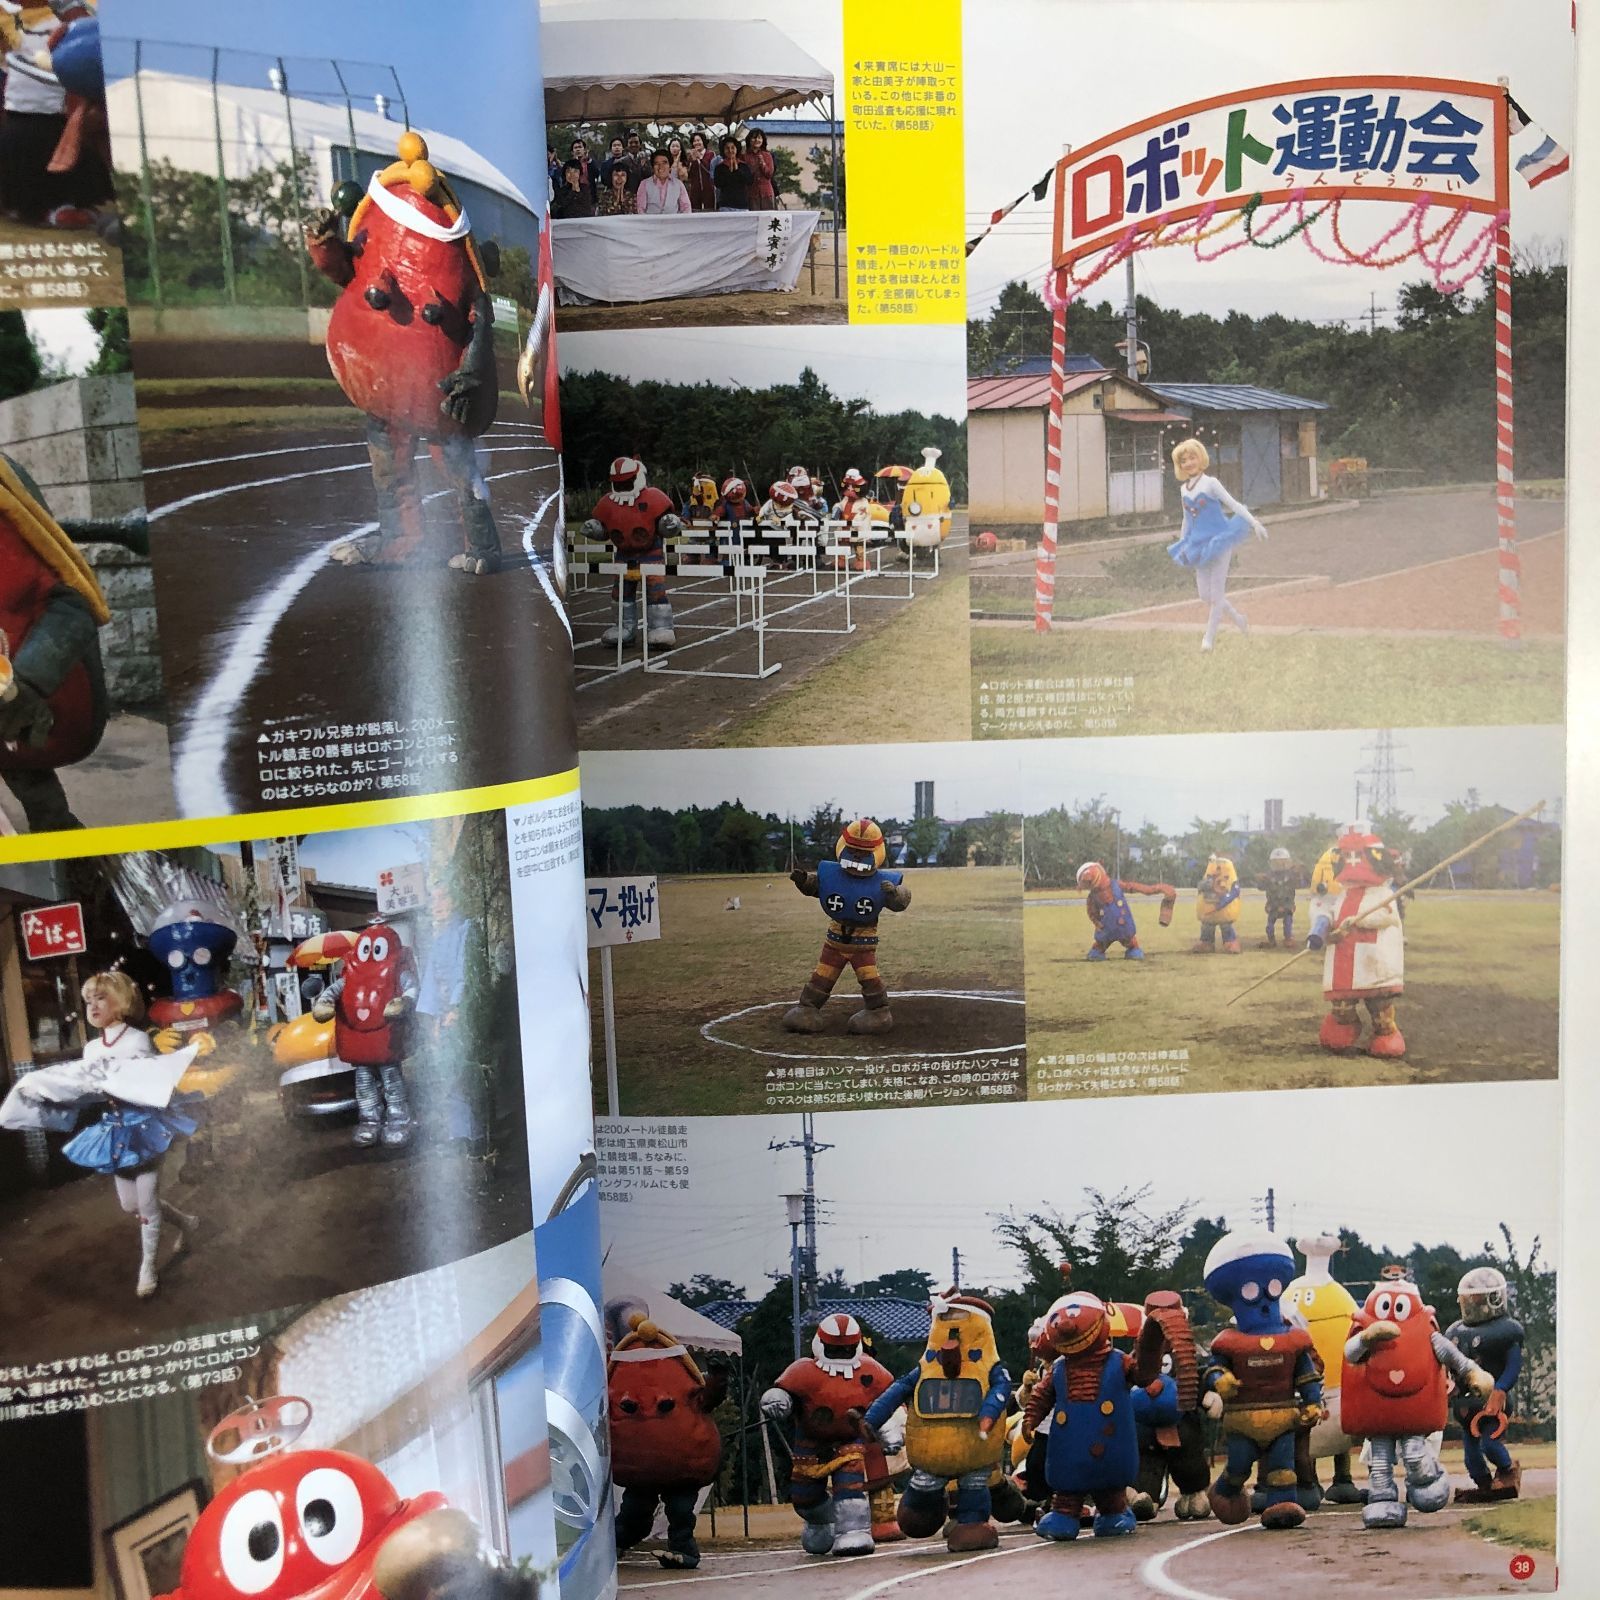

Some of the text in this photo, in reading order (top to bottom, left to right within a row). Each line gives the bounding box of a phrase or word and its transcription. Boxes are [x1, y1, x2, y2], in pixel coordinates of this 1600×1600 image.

[852, 76, 957, 87] 家と由美子が陣取って
[852, 91, 956, 101] いる。この他に非番の
[852, 105, 956, 116] 町田巡査も応援に現れ
[1071, 94, 1484, 240] ロボット運動会
[1285, 171, 1461, 191] うんどうかい
[856, 274, 960, 285] 越せる者はほとんどお
[27, 914, 81, 949] たばこ
[776, 1057, 1019, 1078] 第4種目はハンマー投げ。ロボガキの投げたハンマーは
[596, 1138, 688, 1148] 影は埼玉県東松山市
[598, 1151, 687, 1162] 上競技場。ちなみに、
[1515, 1561, 1529, 1573] 38
